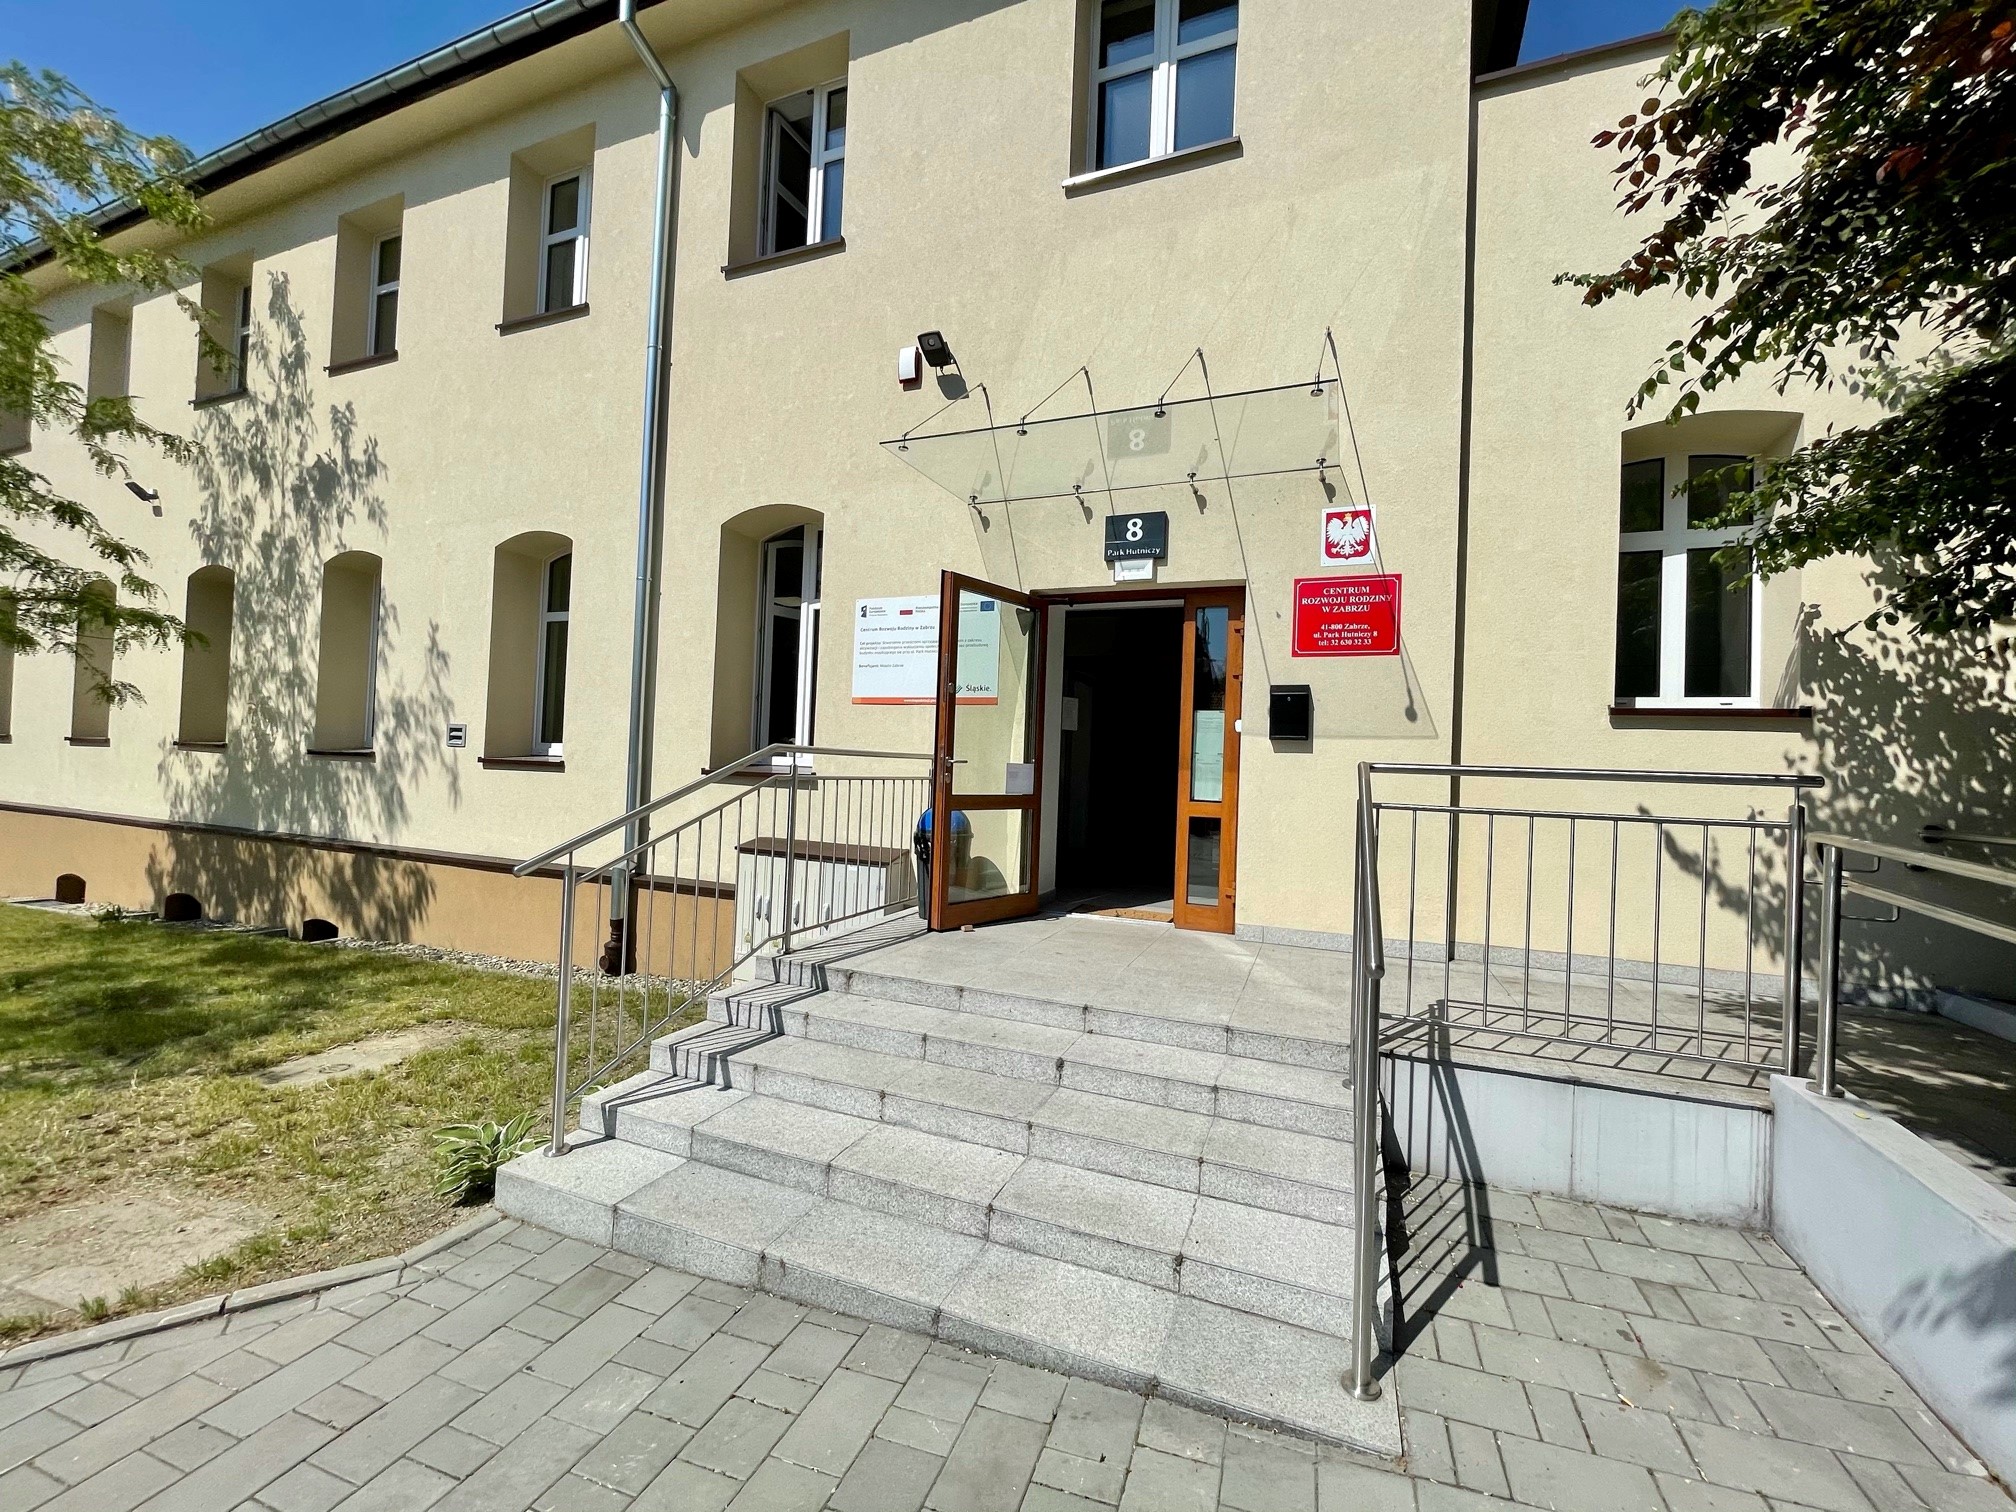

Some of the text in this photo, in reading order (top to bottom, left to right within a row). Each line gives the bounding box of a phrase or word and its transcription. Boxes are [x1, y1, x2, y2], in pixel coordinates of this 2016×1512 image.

[1126, 518, 1143, 541] 8
[1126, 547, 1160, 555] Hutniczy
[1323, 586, 1370, 595] CENTRUM
[1302, 594, 1393, 605] ROZWOJU RODZINY
[1341, 631, 1371, 639] Hutniczy
